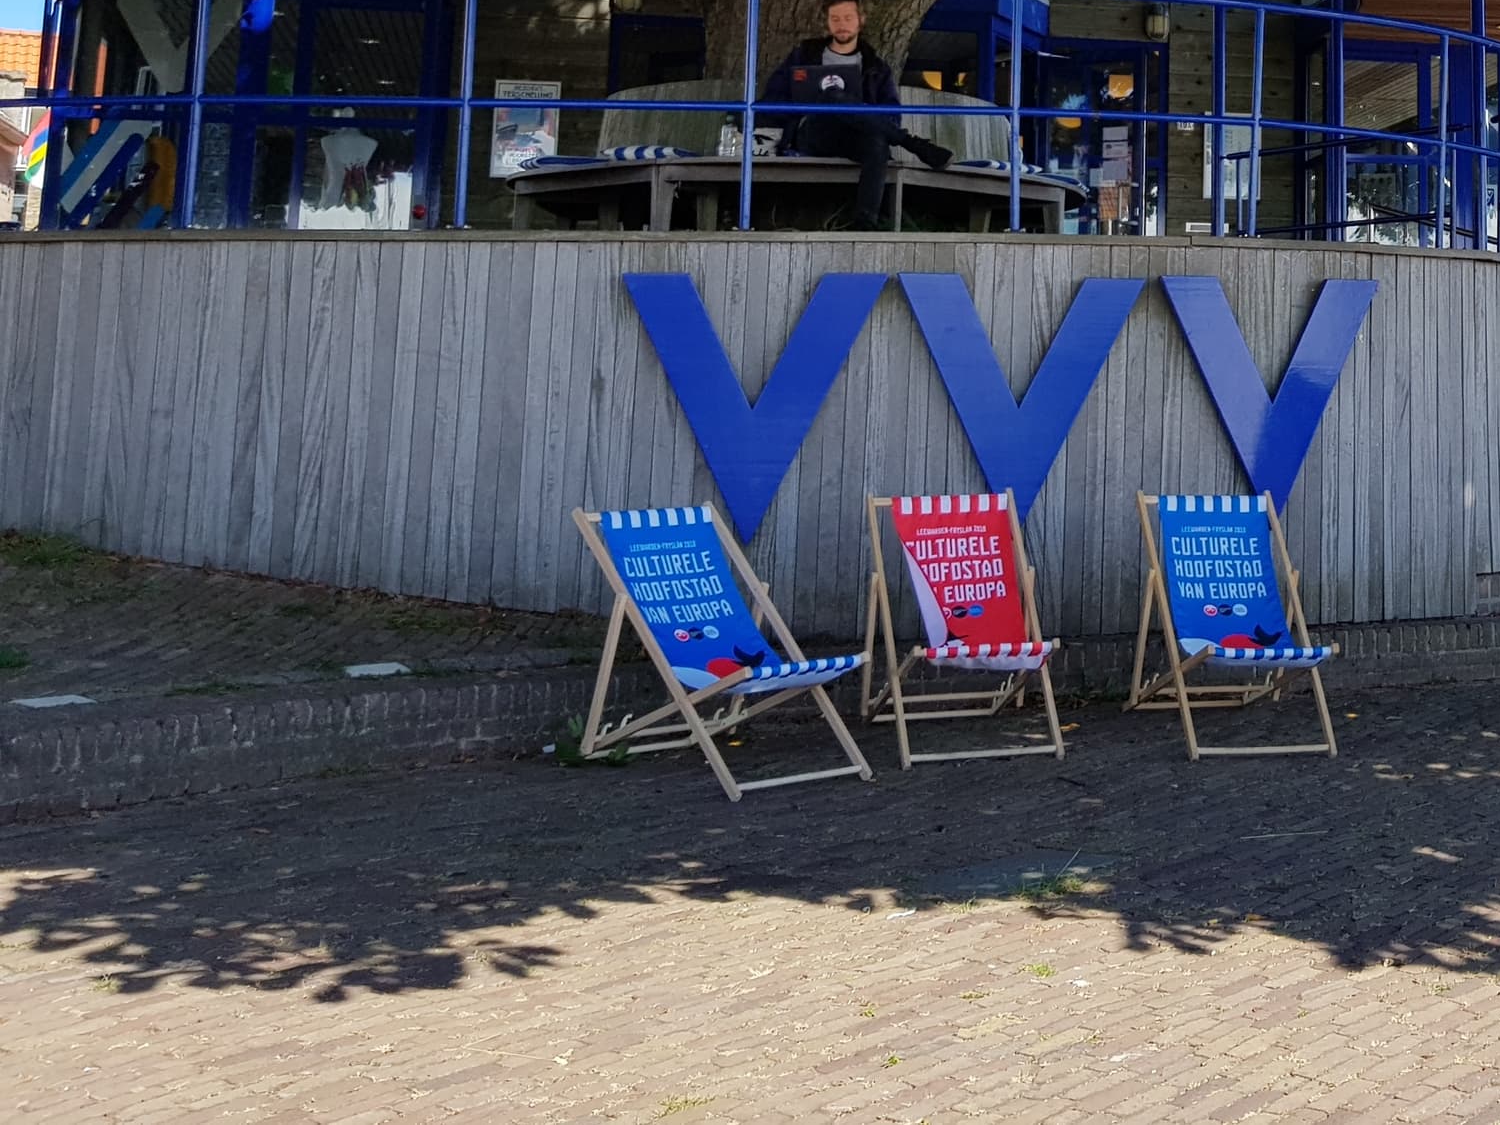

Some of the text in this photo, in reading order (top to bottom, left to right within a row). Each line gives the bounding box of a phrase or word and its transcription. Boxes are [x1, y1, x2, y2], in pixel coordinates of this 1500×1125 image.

[622, 272, 1380, 544] VVV
[1171, 537, 1260, 556] CULTURELE
[623, 551, 715, 577] CULTURELE
[944, 580, 1007, 604] EUROPA
[1178, 581, 1205, 599] VAN
[1209, 581, 1267, 599] EUROPA
[672, 599, 734, 623] EUROPA
